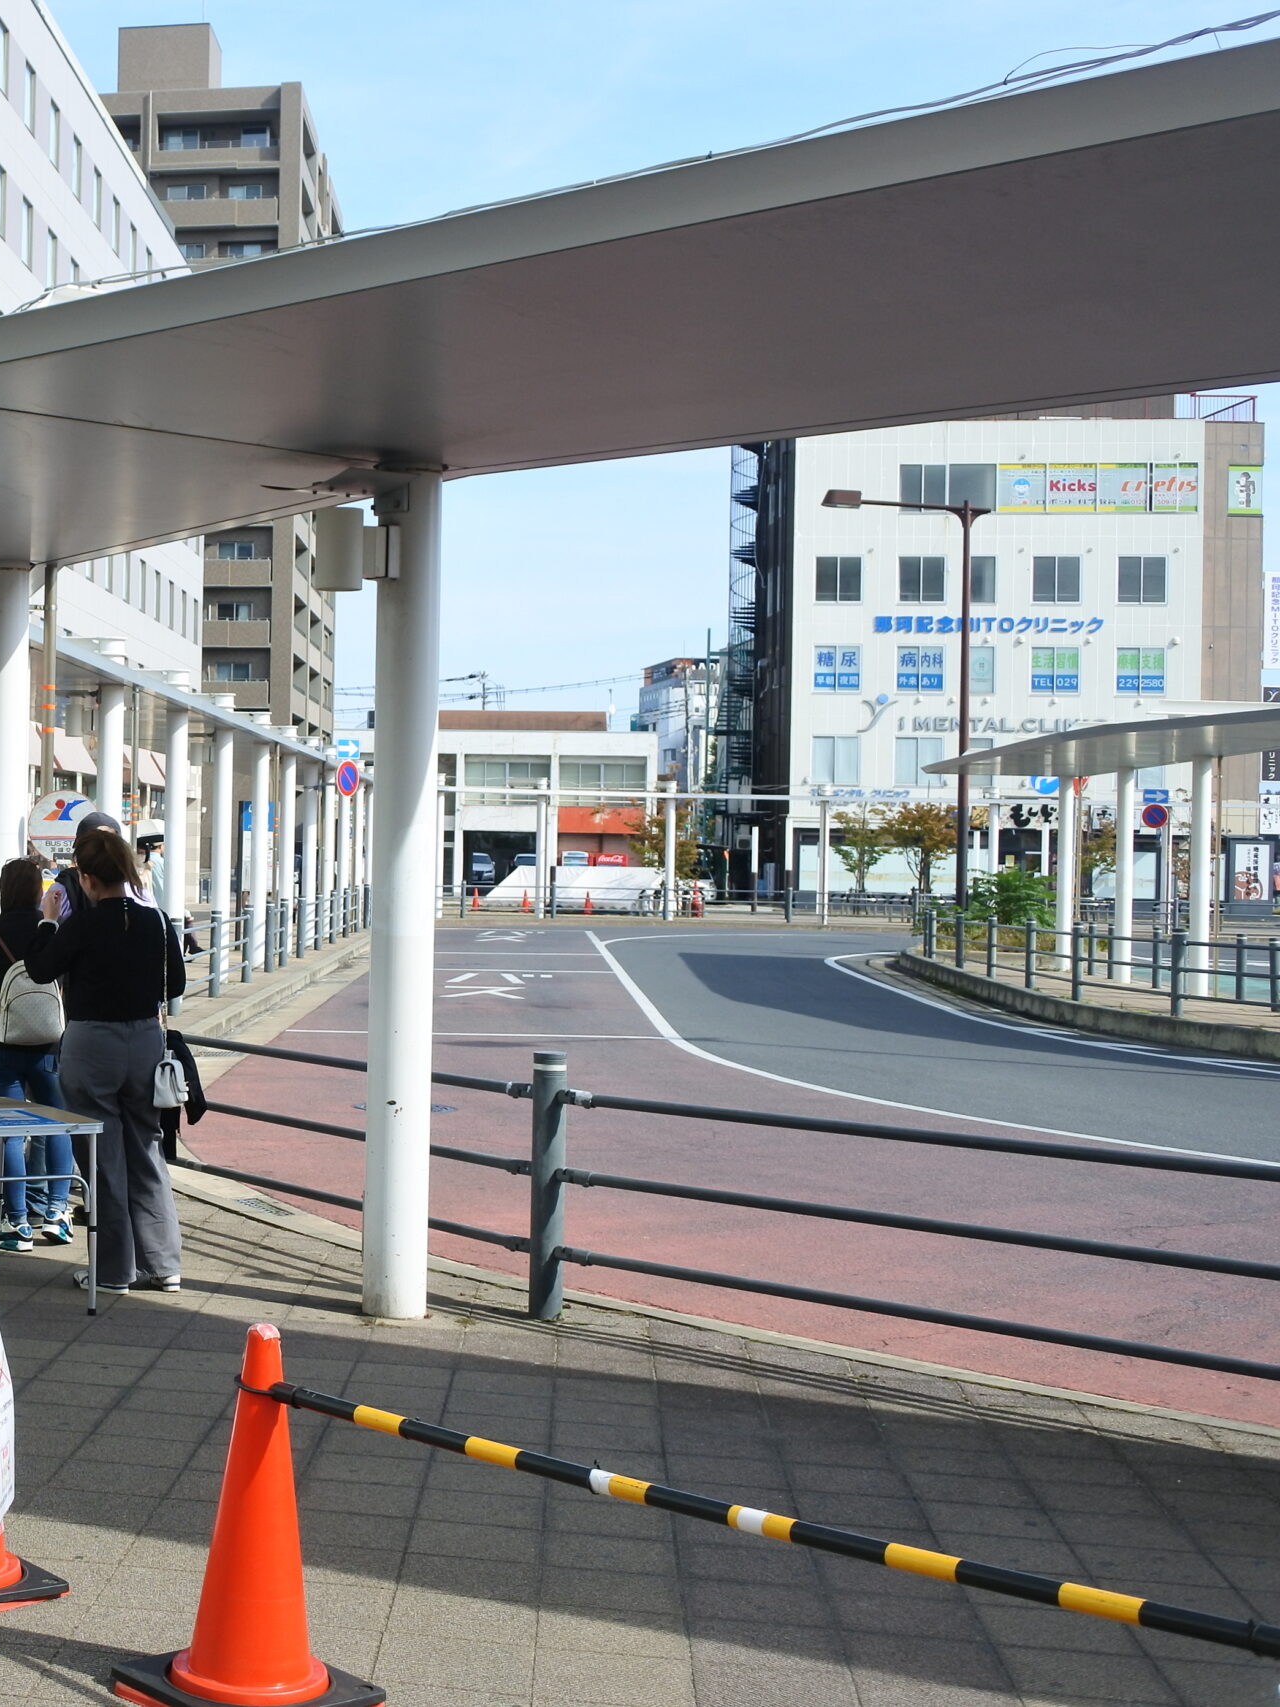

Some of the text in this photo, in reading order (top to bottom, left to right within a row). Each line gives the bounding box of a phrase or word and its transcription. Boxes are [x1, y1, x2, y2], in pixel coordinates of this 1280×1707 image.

[1049, 478, 1097, 492] Kicks
[873, 616, 1105, 634] 那珂記念MITOクリニック
[816, 651, 857, 667] 糖尿
[900, 651, 943, 668] 病内科
[899, 676, 939, 686] 外来あり
[1033, 678, 1078, 687] TEL 029
[1119, 678, 1165, 687] 229 2580
